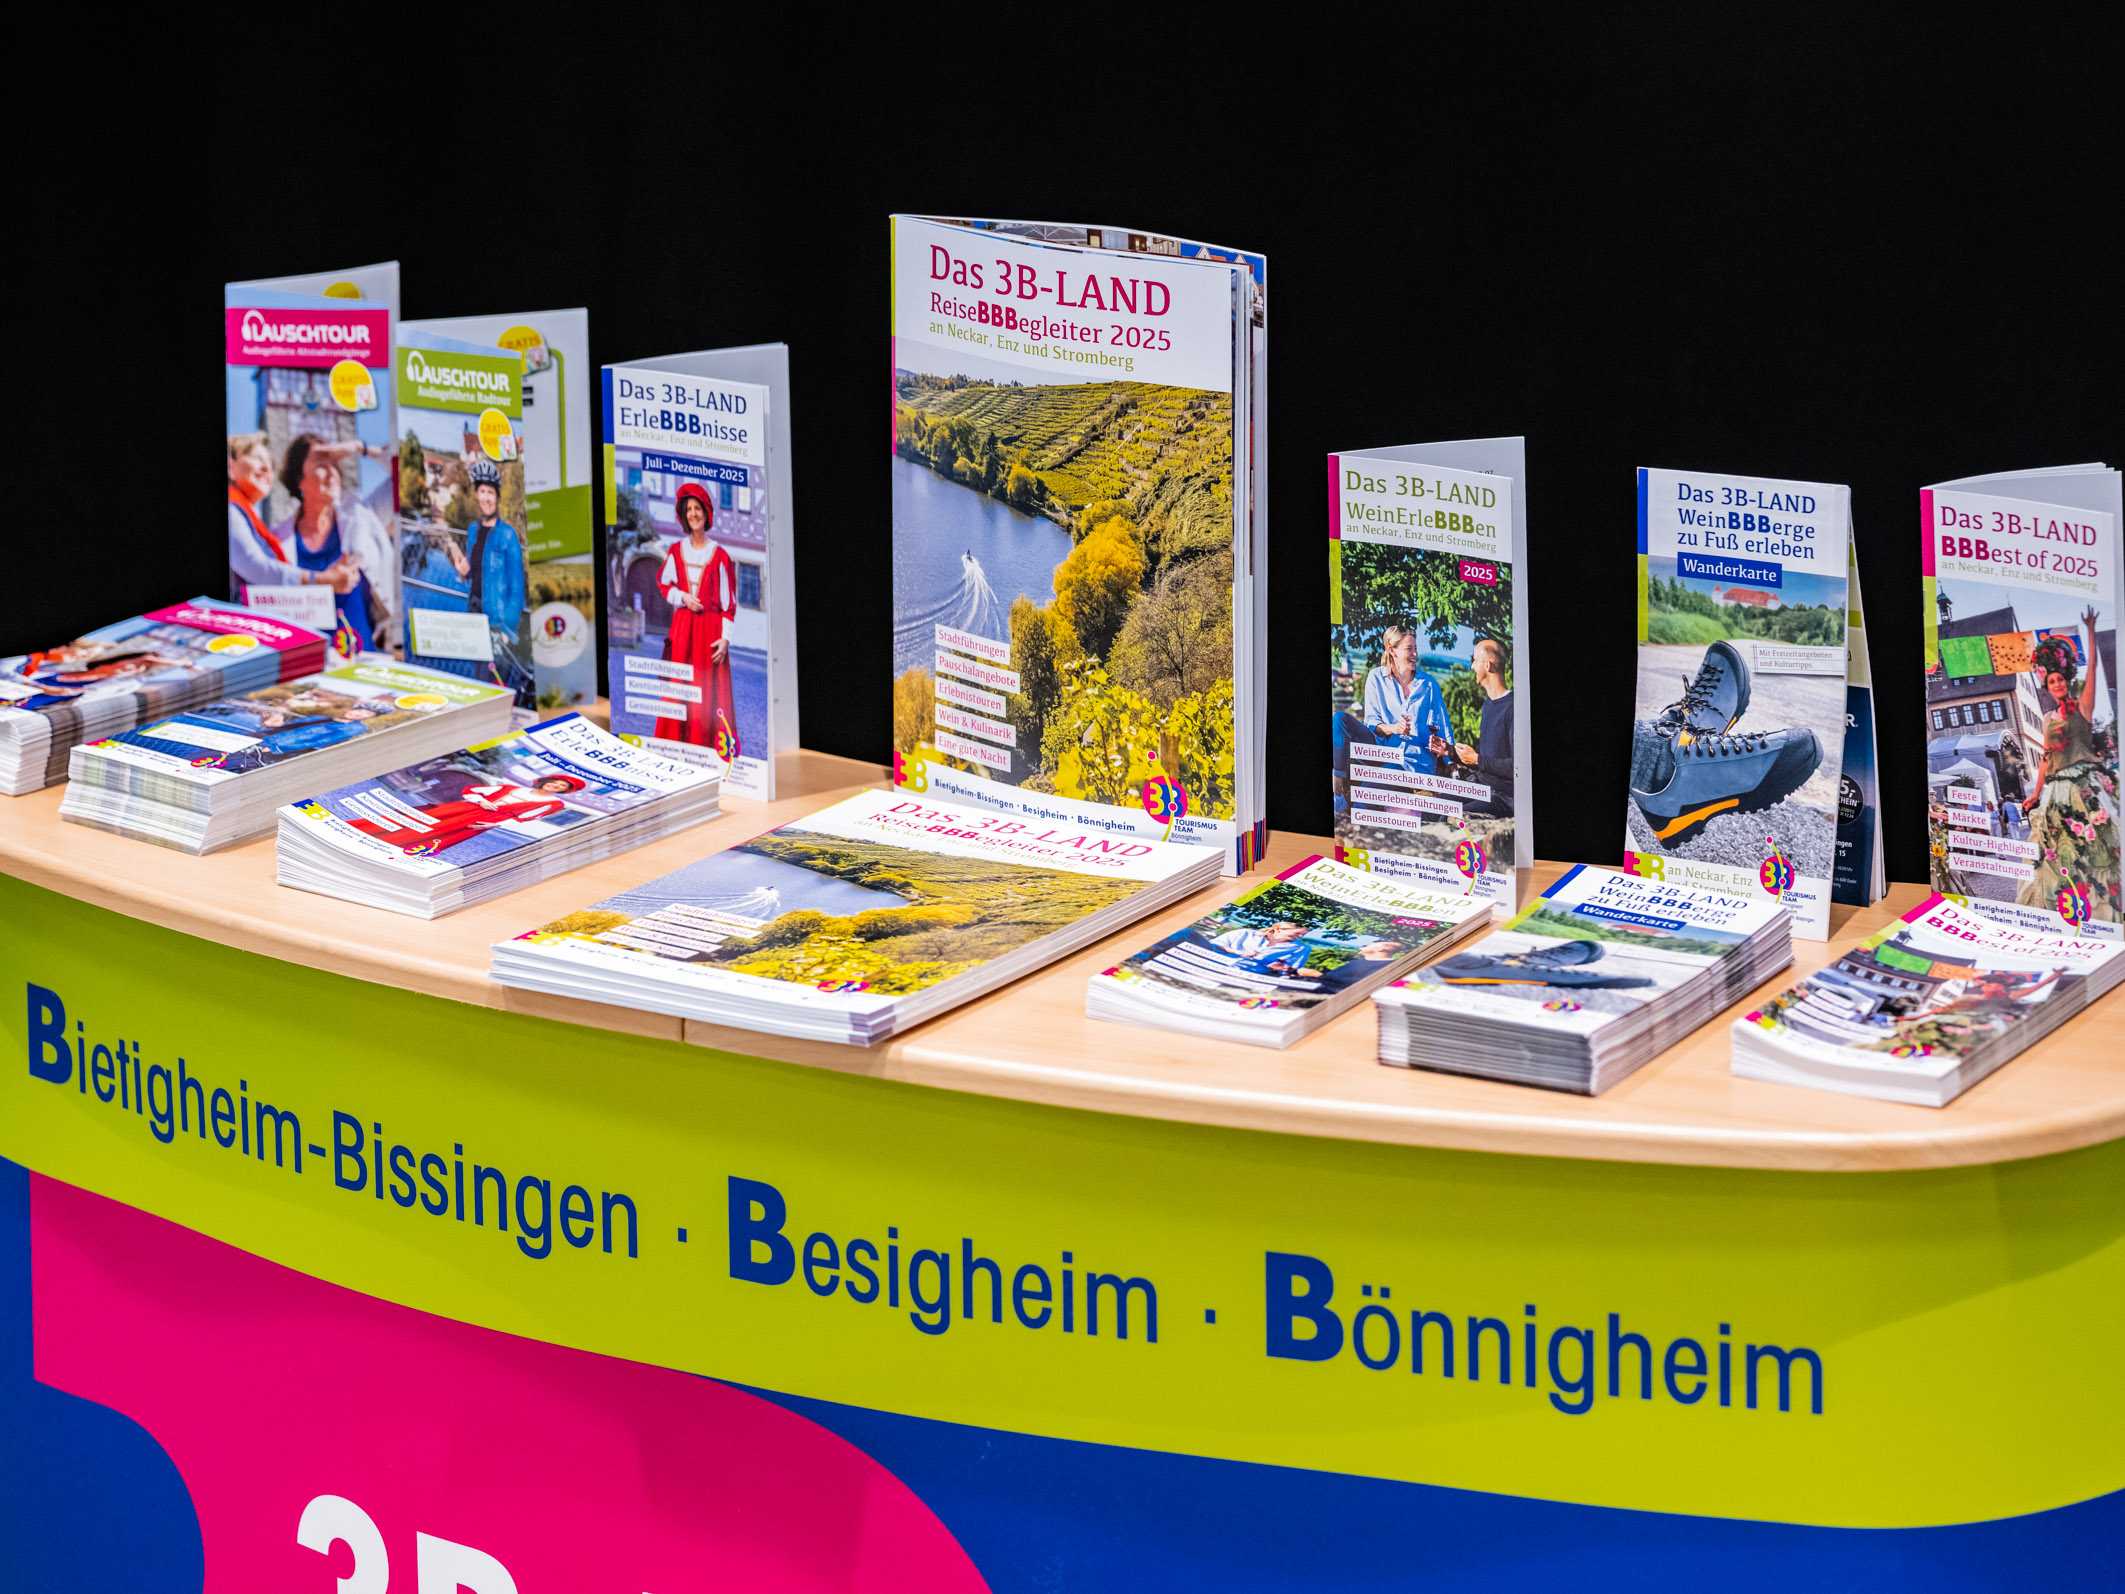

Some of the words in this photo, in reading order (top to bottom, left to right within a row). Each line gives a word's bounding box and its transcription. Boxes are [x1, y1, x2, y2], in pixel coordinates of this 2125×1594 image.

[930, 244, 983, 289] Das
[995, 259, 1171, 316] 3B-LAND
[252, 323, 371, 344] LAUSCHTOUR
[930, 292, 1103, 344] ReiseBBBegleiter
[1110, 325, 1171, 351] 2025
[930, 323, 944, 334] an
[947, 323, 993, 349] Neckar,
[997, 335, 1020, 352] Enz
[1023, 340, 1049, 358] und
[1052, 345, 1134, 373] Stromberg
[414, 362, 511, 392] LAUSCHTOUR
[477, 391, 511, 406] Radtour
[619, 378, 655, 402] Das
[662, 384, 747, 415] 3B-LAND
[620, 407, 748, 443] ErleBBBnisse
[620, 430, 631, 438] an
[634, 429, 668, 444] Neckar,
[670, 434, 685, 445] Enz
[688, 437, 703, 448] und
[705, 439, 748, 457] Stromberg
[645, 455, 663, 470] Juli
[671, 460, 718, 479] Dezember
[720, 468, 745, 482] 2025
[1345, 470, 1387, 493] Das
[1395, 475, 1496, 508] 3B-LAND
[1678, 482, 1714, 504] Das
[1721, 487, 1816, 514] 3B-LAND
[1345, 501, 1497, 539] WeinErleBBBen
[1678, 508, 1815, 542] WeinBBBerge
[1940, 505, 1983, 530] Das
[1992, 511, 2097, 546] 3B-LAND
[1346, 525, 1359, 533] an
[1362, 524, 1402, 539] Neckar,
[1405, 529, 1423, 541] Enz
[1426, 531, 1444, 544] und
[1446, 534, 1497, 555] Stromberg
[1677, 532, 1698, 546] zu
[1705, 531, 1739, 550] Fuß
[1745, 537, 1815, 560] erleben
[1683, 557, 1777, 582] Wanderkarte
[1941, 535, 2022, 566] BBBest
[2027, 550, 2048, 570] of
[2052, 554, 2098, 578] 2025
[1464, 565, 1493, 581] 2025
[1942, 561, 1955, 570] an
[2002, 567, 2019, 579] Enz
[2023, 569, 2042, 582] und
[2045, 573, 2098, 594] Stromberg
[938, 629, 1006, 658] Stadtführungen
[1759, 649, 1771, 657] Mit
[1772, 650, 1833, 660] Freizeitangeboten
[628, 659, 691, 677] Stadtführungen
[939, 655, 1016, 688] Pauschalangebote
[1774, 660, 1812, 670] Kulturtipps
[628, 681, 699, 698] Kostümführungen
[939, 682, 1002, 711] Erlebnistouren
[628, 701, 683, 716] Genusstouren
[939, 708, 959, 725] Wein
[961, 716, 969, 728] &
[971, 719, 1012, 740] Kulinarik
[550, 729, 674, 783] ErleBBBnisse
[569, 723, 604, 746] Das
[607, 742, 695, 778] 3B-LAND
[938, 735, 957, 750] Eine
[959, 742, 978, 757] gute
[980, 748, 1007, 766] Nacht
[1354, 746, 1401, 761] Weinfeste
[1354, 767, 1425, 786] Weinausschank
[1427, 779, 1434, 787] &
[1436, 779, 1488, 798] Weinproben
[1952, 789, 1977, 801] Feste
[935, 778, 1014, 809] Bietigheim-Bissingen
[1022, 804, 1068, 821] Besigheim
[1077, 815, 1136, 832] Bönnigheim
[1354, 790, 1460, 815] Weinerlebnisführungen
[887, 802, 961, 823] Das
[965, 818, 1153, 858] 3B-LAND
[1174, 825, 1194, 834] TEAM
[1175, 819, 1218, 830] TOURISMUS
[1354, 812, 1417, 829] Genusstouren
[1952, 811, 1987, 826] Märkte
[868, 814, 1064, 856] ReiseBBBegleiter
[1065, 849, 1127, 867] 2025
[1953, 834, 2036, 856] Kultur-Highlights
[1374, 856, 1448, 875] Bietigheim-Bissingen
[1374, 866, 1412, 878] Besigheim
[1418, 872, 1460, 886] Bönnigheim
[1668, 864, 1683, 876] an
[1685, 865, 1729, 886] Neckar,
[1733, 873, 1753, 887] Enz
[1953, 856, 2031, 877] Veranstaltungen
[1303, 872, 1456, 916] WeinErleBBBen
[1316, 863, 1358, 884] Das
[1363, 880, 1473, 908] 3B-LAND
[1606, 876, 1646, 891] Das
[1650, 885, 1748, 910] 3B-LAND
[1782, 895, 1798, 903] TEAM
[1783, 890, 1817, 901] TOURISMUS
[1582, 905, 1679, 929] Wanderkarte
[1587, 895, 1610, 905] zu
[1612, 897, 1650, 914] Fuß
[1656, 906, 1728, 926] erleben
[1599, 886, 1737, 920] WeinBBBerge
[1974, 902, 2051, 923] Bietigheim-Bissingen
[1397, 917, 1431, 927] 2025
[1940, 908, 1986, 932] Das
[1991, 928, 2107, 952] 3B-LAND
[2020, 920, 2062, 935] Bönnigheim
[1926, 916, 2012, 951] BBBest
[2040, 949, 2092, 960] 2025
[27, 981, 639, 1260] Bietigheim-Bissingen
[727, 1175, 1158, 1344] Besigheim
[1265, 1250, 1824, 1416] Bönnigheim
